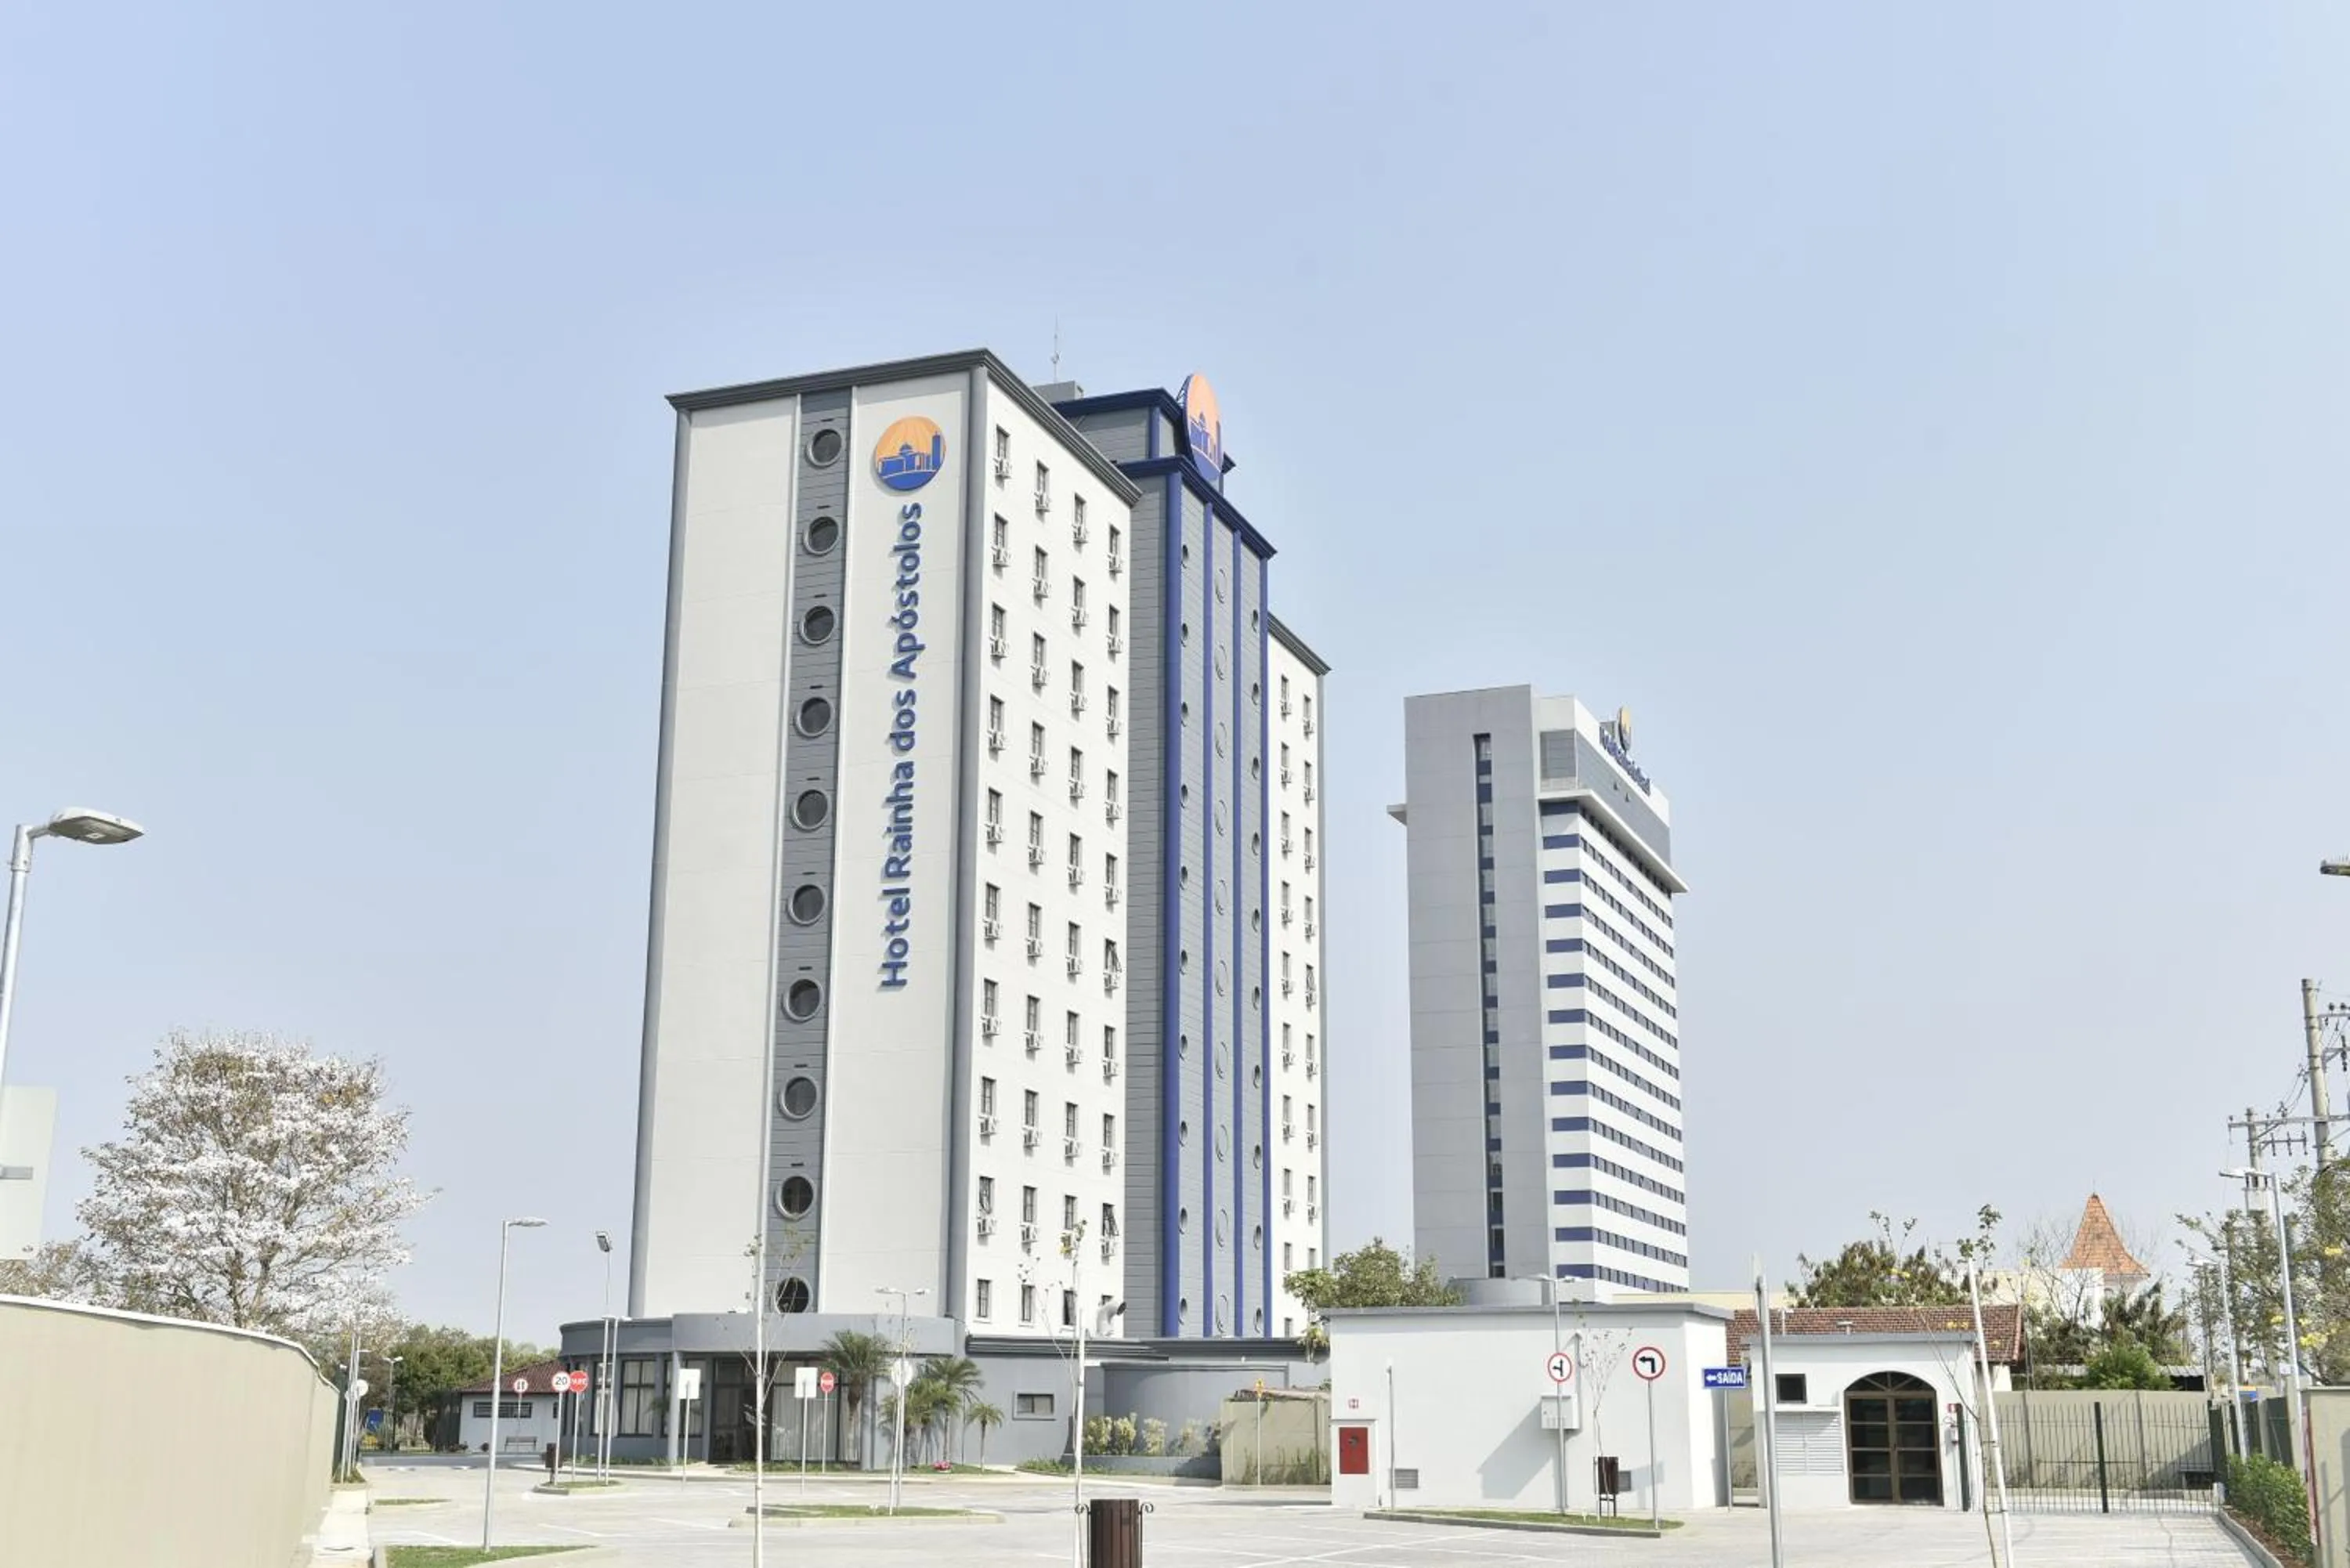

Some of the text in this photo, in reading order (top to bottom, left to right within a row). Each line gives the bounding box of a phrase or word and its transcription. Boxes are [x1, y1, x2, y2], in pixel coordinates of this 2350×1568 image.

[881, 502, 926, 986] Hotel Rainha dos Apóstolos
[555, 1376, 568, 1386] 20
